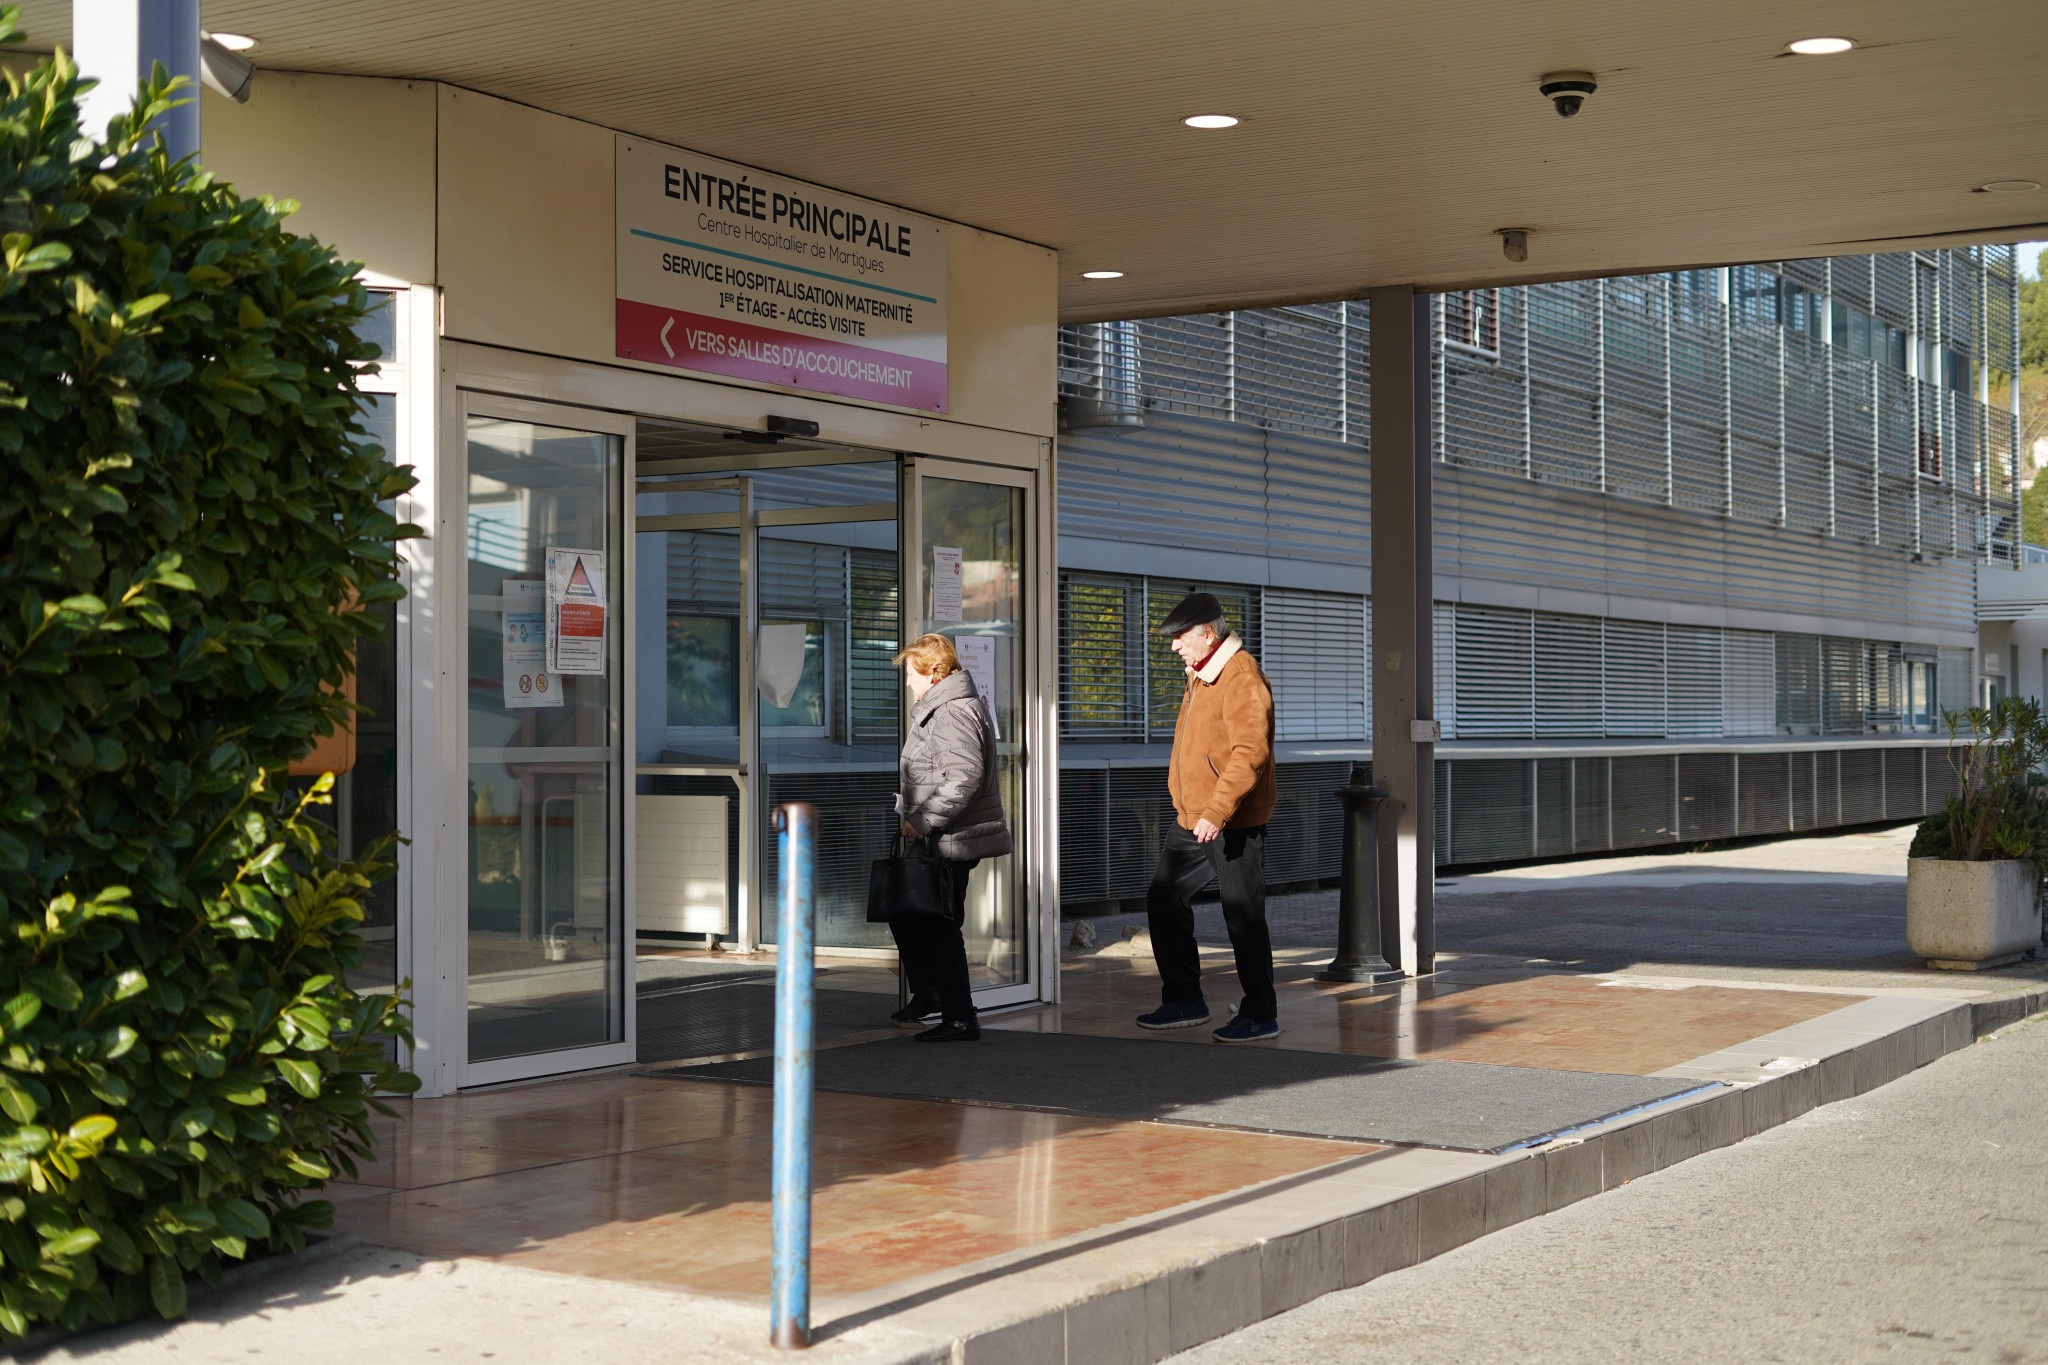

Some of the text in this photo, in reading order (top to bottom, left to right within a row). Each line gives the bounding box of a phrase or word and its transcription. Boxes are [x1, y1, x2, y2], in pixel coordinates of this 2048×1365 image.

[665, 164, 910, 257] ENTRÉE PRINCIPALE
[698, 213, 884, 274] Centre Hospitalier de Martigues
[662, 253, 913, 324] SERVICE HOSPITALISATION MATERNITÉ
[736, 292, 778, 319] ÉTAGE
[787, 307, 827, 329] ACCÈS
[829, 316, 865, 337] VISITE
[686, 327, 725, 355] VERS
[728, 336, 780, 365] SALLES
